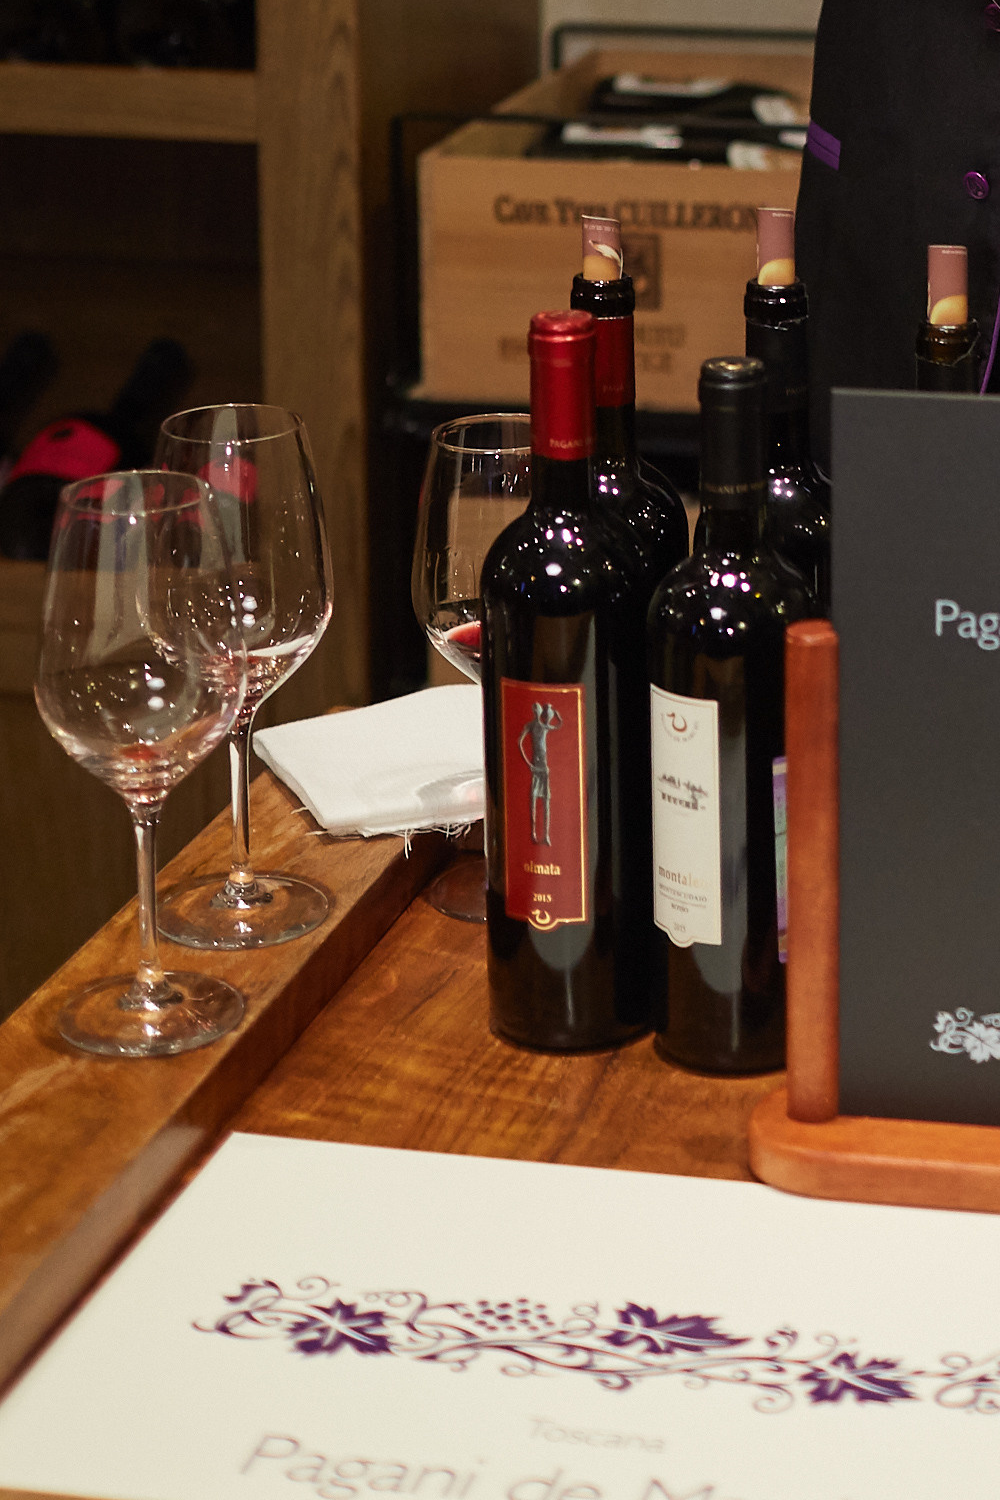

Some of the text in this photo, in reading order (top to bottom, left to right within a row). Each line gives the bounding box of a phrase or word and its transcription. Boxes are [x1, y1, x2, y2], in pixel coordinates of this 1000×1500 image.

[528, 1417, 667, 1455] Toscana
[240, 1432, 488, 1500] Pagani
[506, 1467, 602, 1500] de
